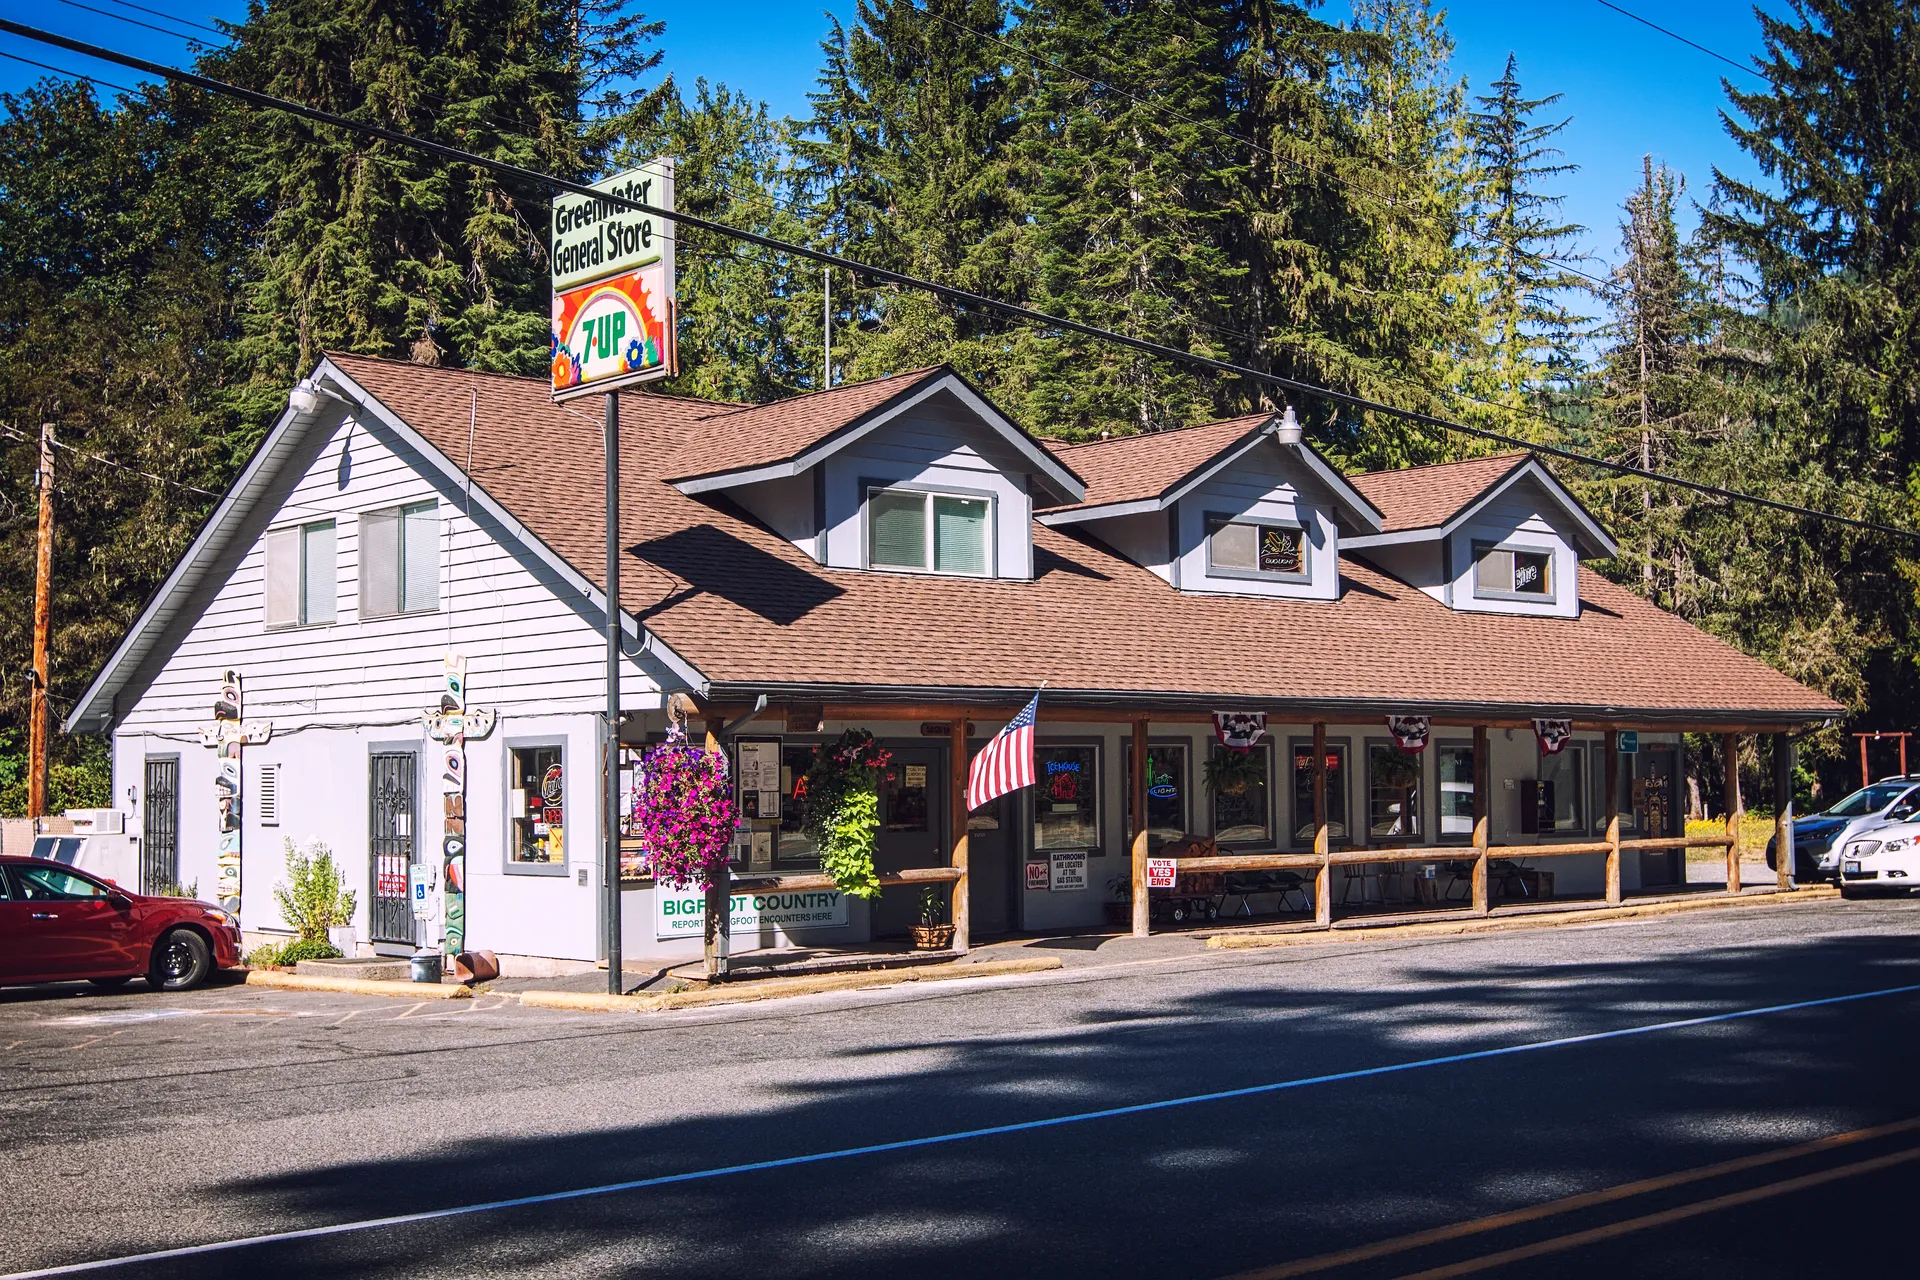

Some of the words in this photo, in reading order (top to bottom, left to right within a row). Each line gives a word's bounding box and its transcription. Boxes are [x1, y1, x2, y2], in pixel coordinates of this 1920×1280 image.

[553, 224, 604, 277] General
[607, 219, 652, 261] Store
[1046, 761, 1080, 775] ICEHOUSE
[1052, 853, 1086, 861] BATHROOMS
[1029, 866, 1039, 880] NO
[1152, 868, 1171, 877] YES
[1151, 878, 1171, 886] EMS
[752, 892, 840, 911] COUNTRY
[759, 914, 811, 924] ENCOUNTERS
[812, 912, 833, 921] HERE
